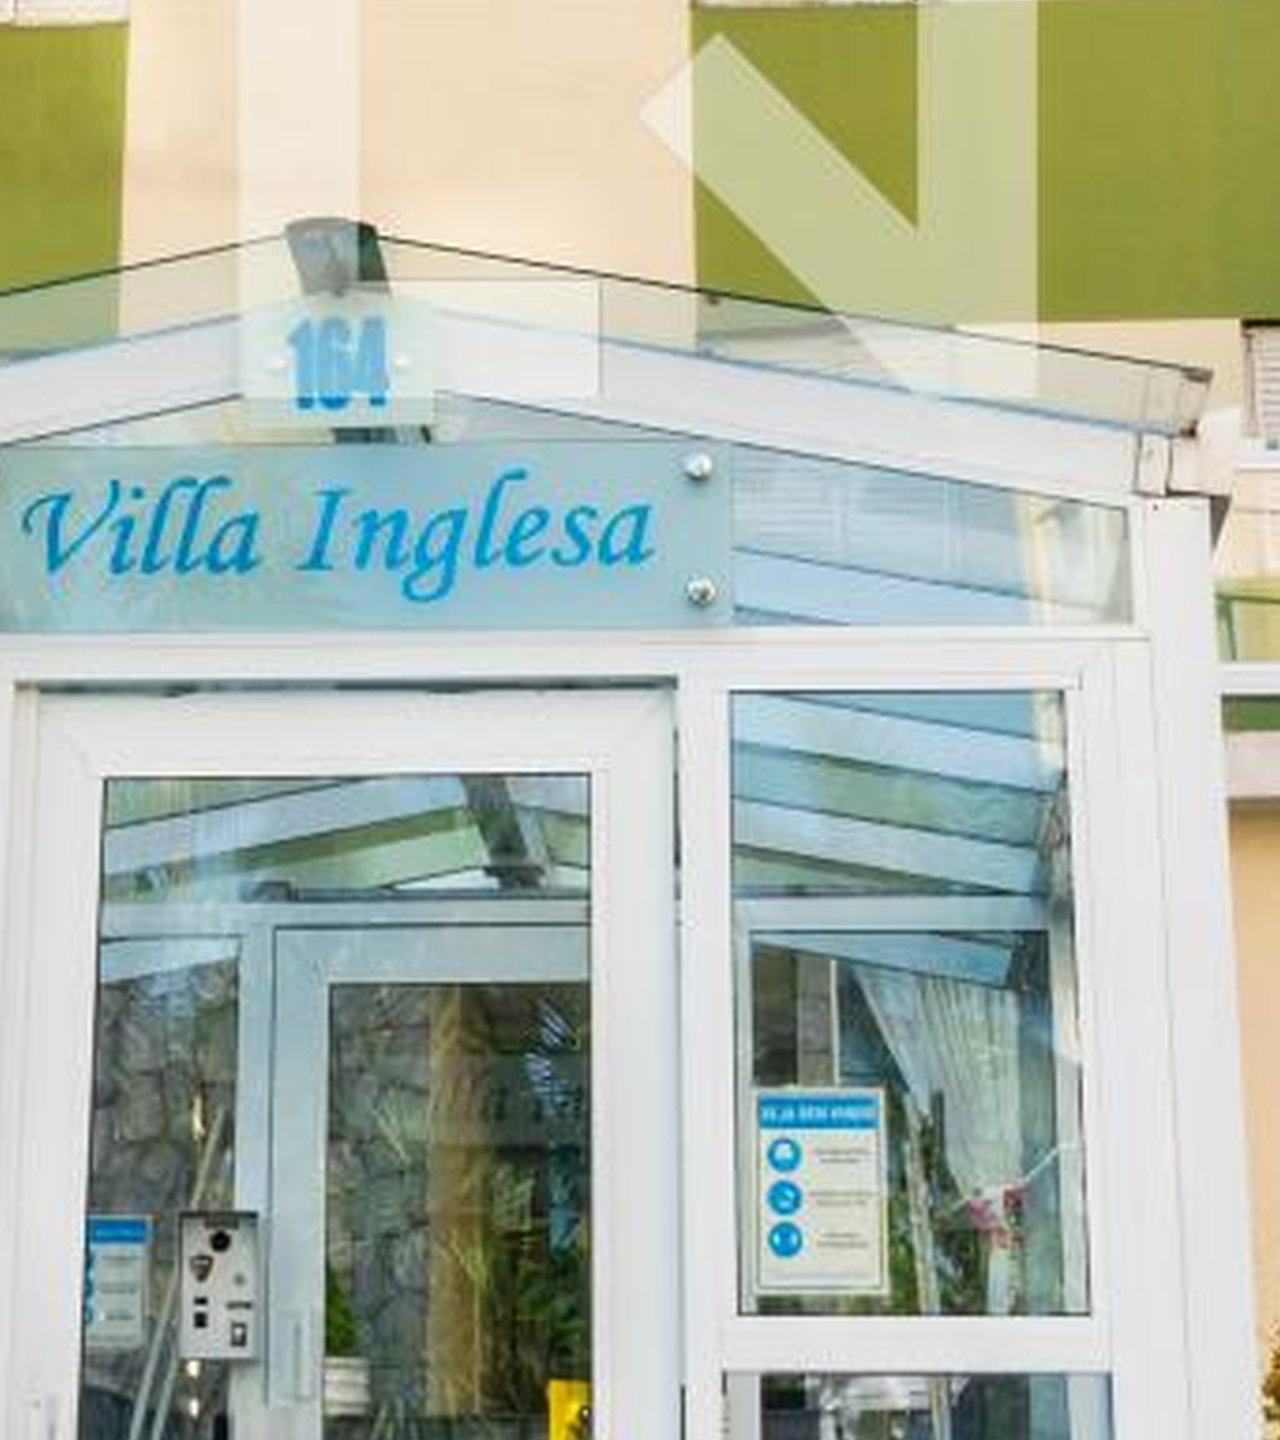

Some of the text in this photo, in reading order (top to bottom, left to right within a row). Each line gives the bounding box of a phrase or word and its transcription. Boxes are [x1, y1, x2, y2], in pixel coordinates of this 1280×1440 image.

[285, 315, 390, 412] 164
[20, 469, 656, 604] Villa Inglesa
